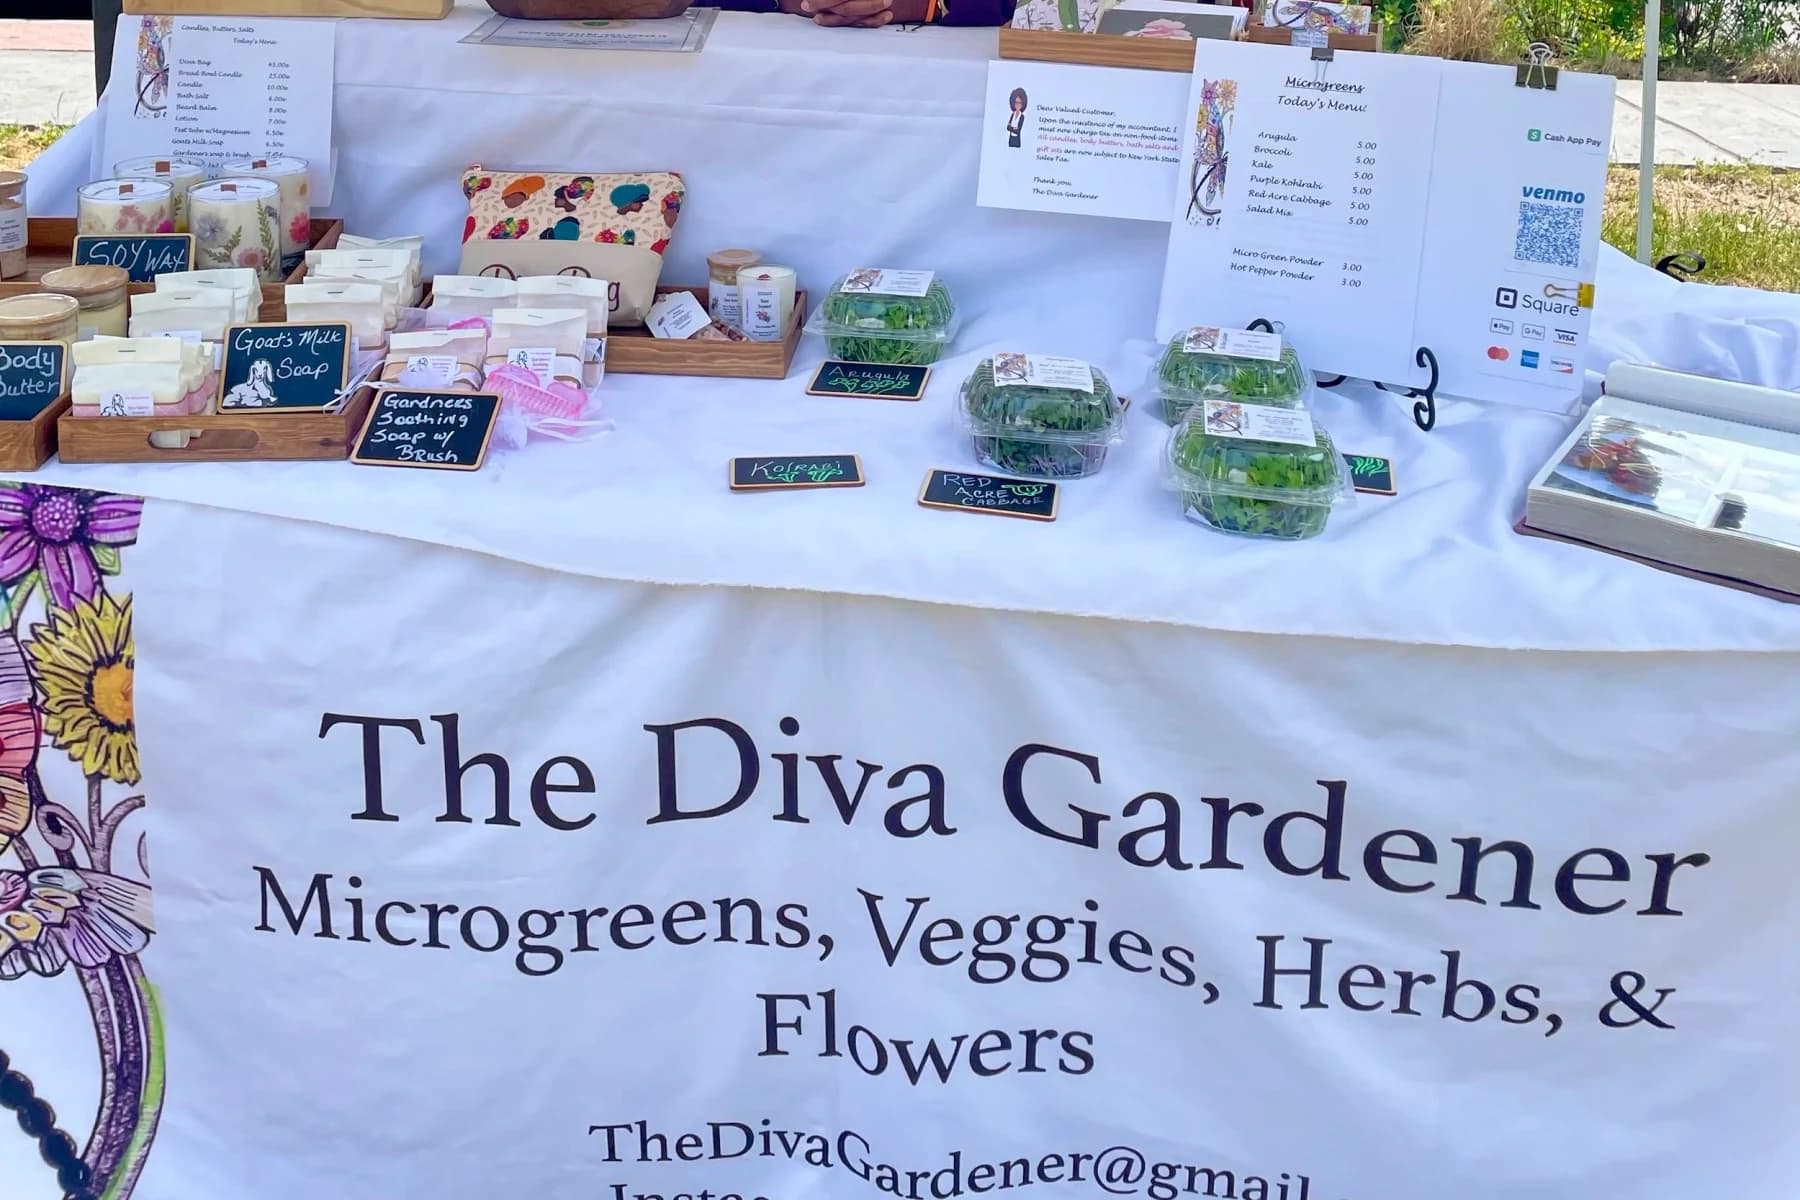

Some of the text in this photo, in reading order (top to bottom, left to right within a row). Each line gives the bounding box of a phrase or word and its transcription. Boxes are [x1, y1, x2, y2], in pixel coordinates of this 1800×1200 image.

[1285, 76, 1365, 93] Microgreens
[1278, 95, 1326, 110] Today's
[1258, 131, 1377, 150] Arugula 5.00
[1544, 133, 1602, 147] Cash App Pay
[1254, 145, 1375, 165] Broccoli 5.00
[1251, 159, 1373, 180] Kale 5.00
[1250, 174, 1372, 195] Purple Kohlrabi 5.00
[1522, 186, 1586, 204] venmo
[1248, 189, 1370, 211] Red Acre Cabbage 5.00
[1246, 204, 1368, 226] Salad Mix 5.00
[1232, 247, 1362, 272] Micro Green Powder 3.00
[1230, 262, 1362, 288] Hot Pepper Powder 3.00
[1521, 294, 1580, 317] Square
[235, 328, 293, 356] Goat's
[1557, 333, 1575, 342] VISA
[276, 357, 329, 379] Soap
[370, 429, 455, 448] Soap w/
[943, 474, 992, 488] RED
[961, 496, 1045, 506] CABBAGE
[318, 712, 1710, 918] The Diva Gardener
[252, 865, 1677, 1039] Microgreens, Veggies, Herbs, &
[756, 988, 1096, 1087] Flowers
